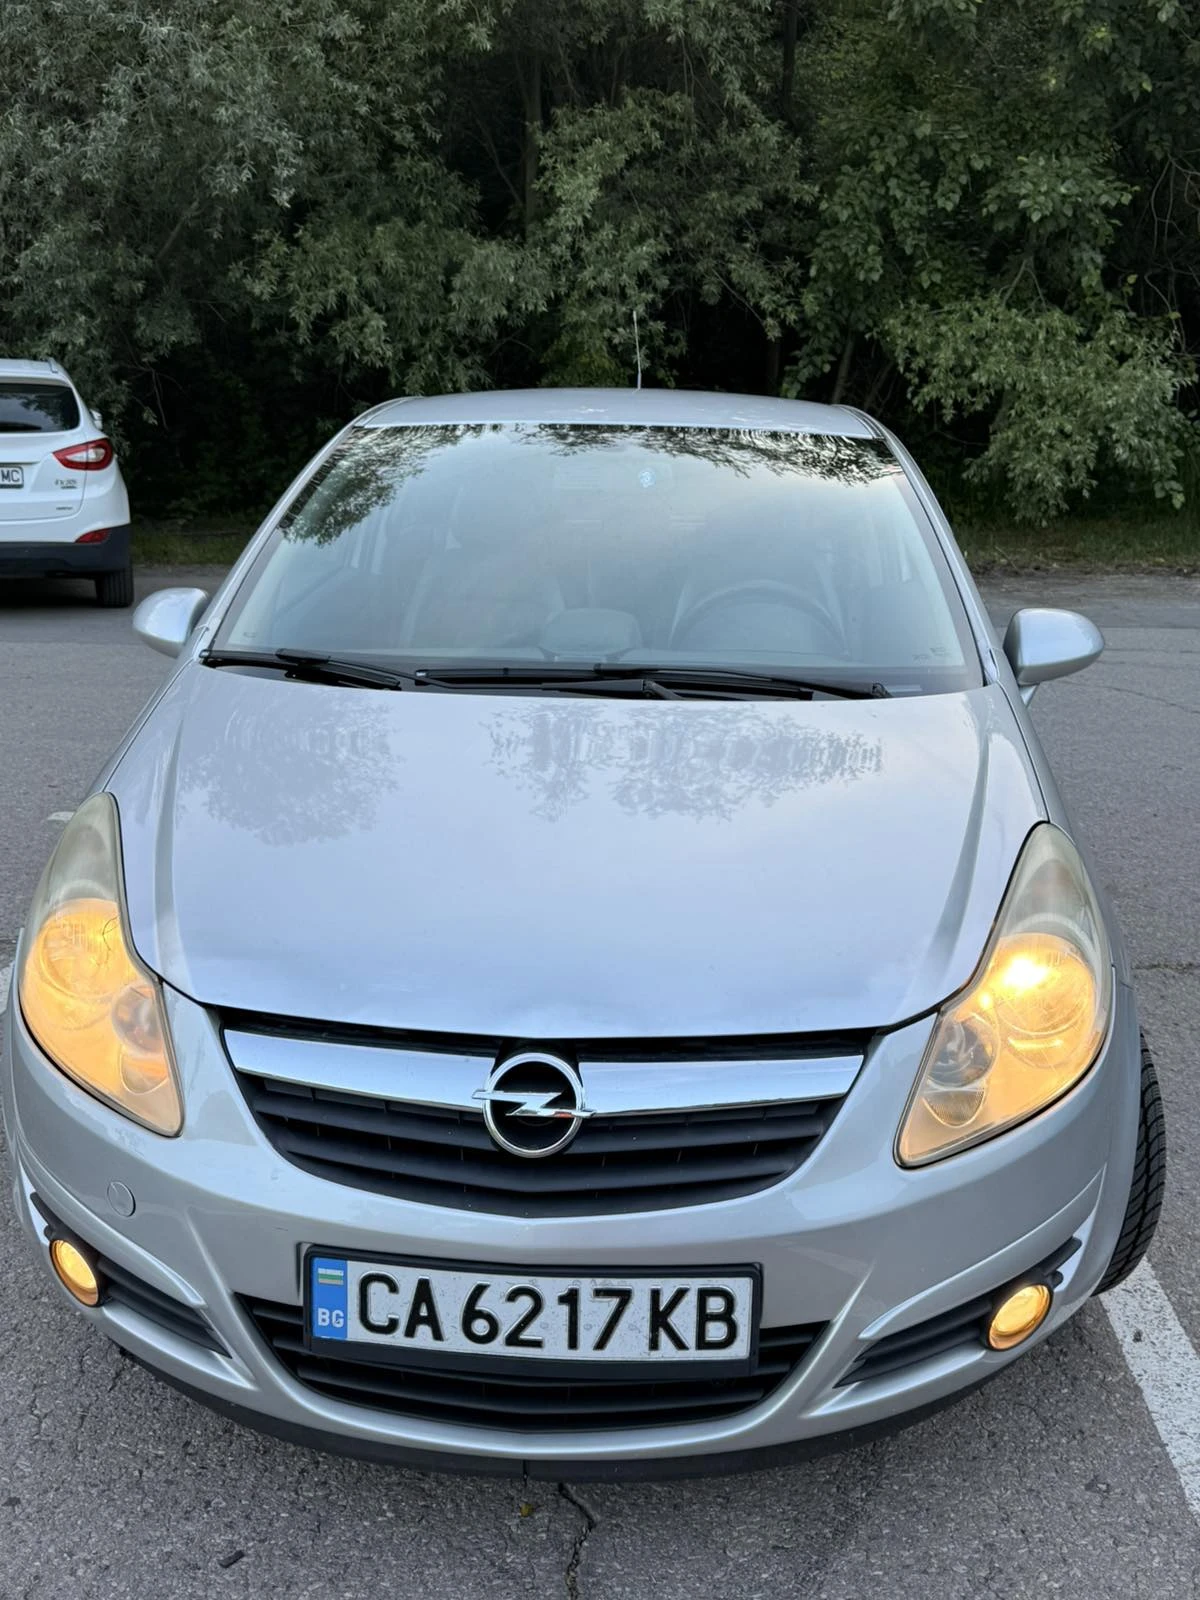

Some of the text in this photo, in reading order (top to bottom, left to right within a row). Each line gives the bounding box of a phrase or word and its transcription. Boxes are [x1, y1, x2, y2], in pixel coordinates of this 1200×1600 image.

[1, 469, 20, 482] MC
[317, 1307, 344, 1328] BG
[359, 1272, 738, 1352] CA 6217 KB
